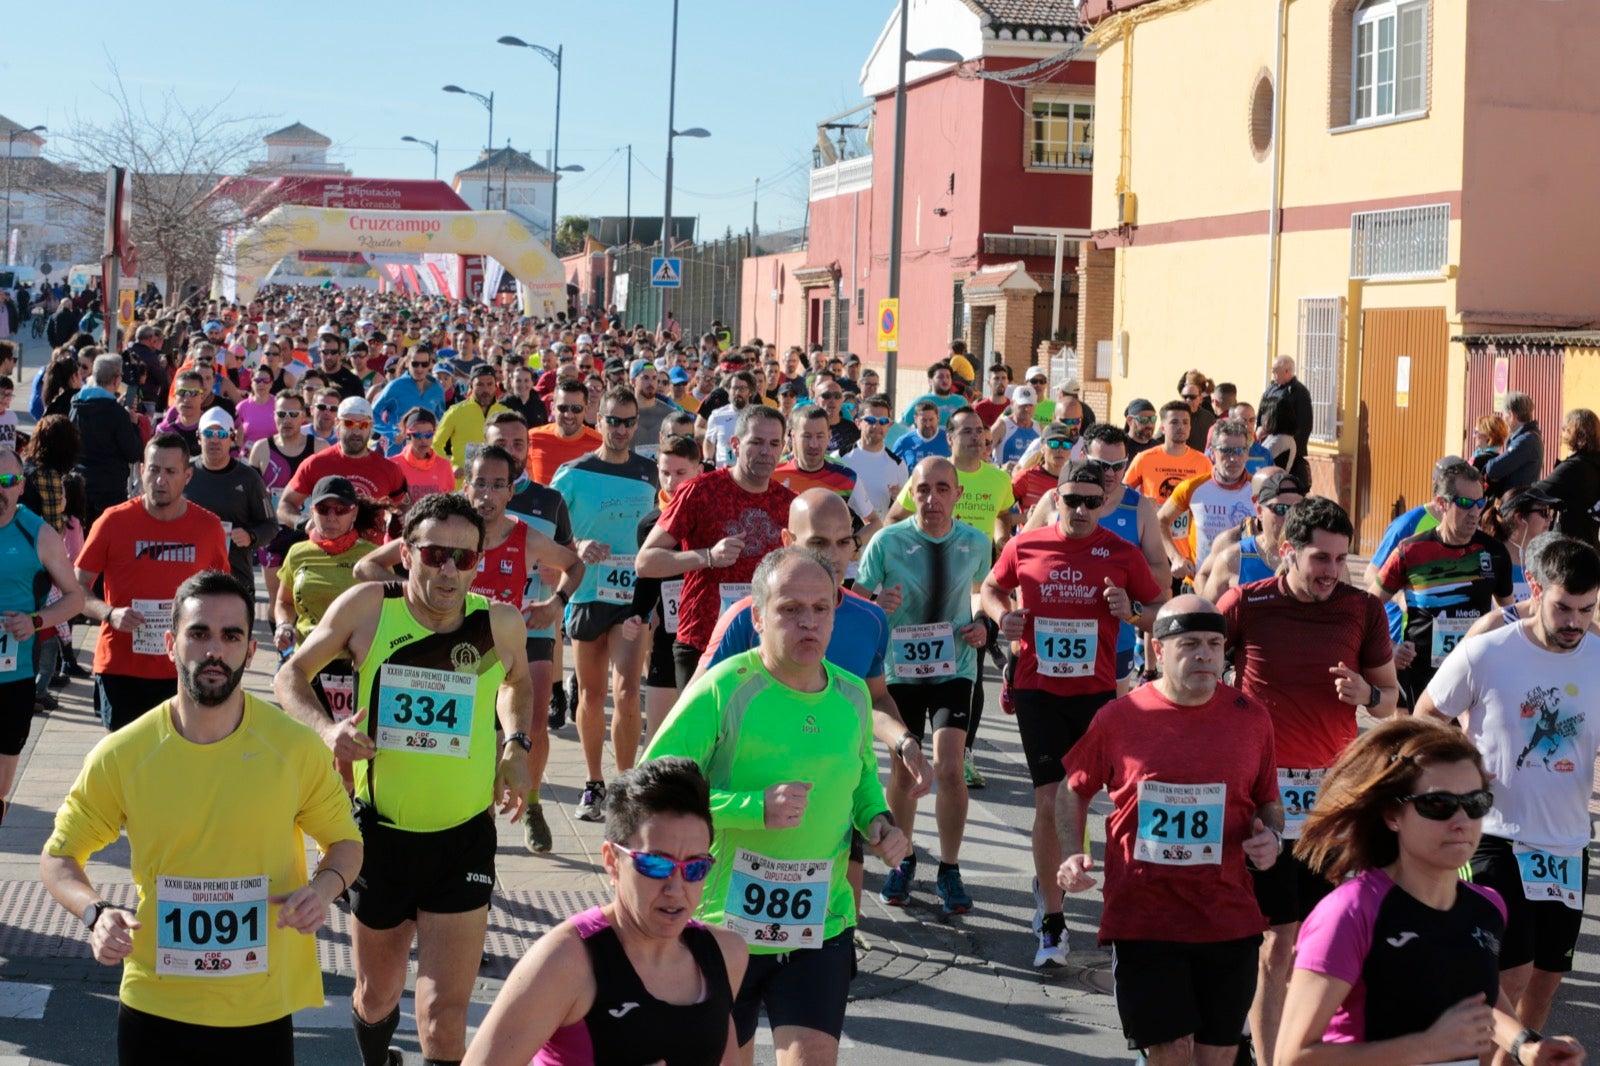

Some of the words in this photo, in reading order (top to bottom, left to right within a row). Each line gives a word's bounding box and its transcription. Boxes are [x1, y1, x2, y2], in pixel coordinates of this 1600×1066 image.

[347, 185, 401, 198] Diputación
[347, 199, 358, 208] de
[348, 215, 440, 233] Cruzcampo
[358, 235, 401, 248] Radler
[1203, 504, 1226, 515] VIII
[135, 540, 196, 563] PUMA
[1091, 546, 1110, 558] edp
[1049, 567, 1083, 583] edp
[668, 598, 680, 615] 3
[1455, 608, 1480, 618] Medio
[903, 640, 944, 661] 397
[1044, 637, 1087, 659] 135
[404, 669, 420, 678] GRAN
[420, 670, 442, 681] PREMIO
[443, 673, 451, 682] DE
[451, 674, 471, 685] FONDO
[393, 692, 457, 729] 334
[1151, 808, 1208, 839] 218
[758, 858, 775, 869] GRAN
[776, 861, 799, 871] PREMIO
[799, 862, 807, 871] DE
[1530, 853, 1568, 885] 361
[164, 879, 182, 889] XXXIII
[183, 880, 201, 890] GRAN
[203, 881, 228, 891] PREMIO
[230, 880, 239, 890] DE
[240, 878, 261, 888] FONDO
[192, 891, 234, 902] DIPUTACIÓN
[742, 883, 812, 919] 986
[164, 906, 258, 945] 1091
